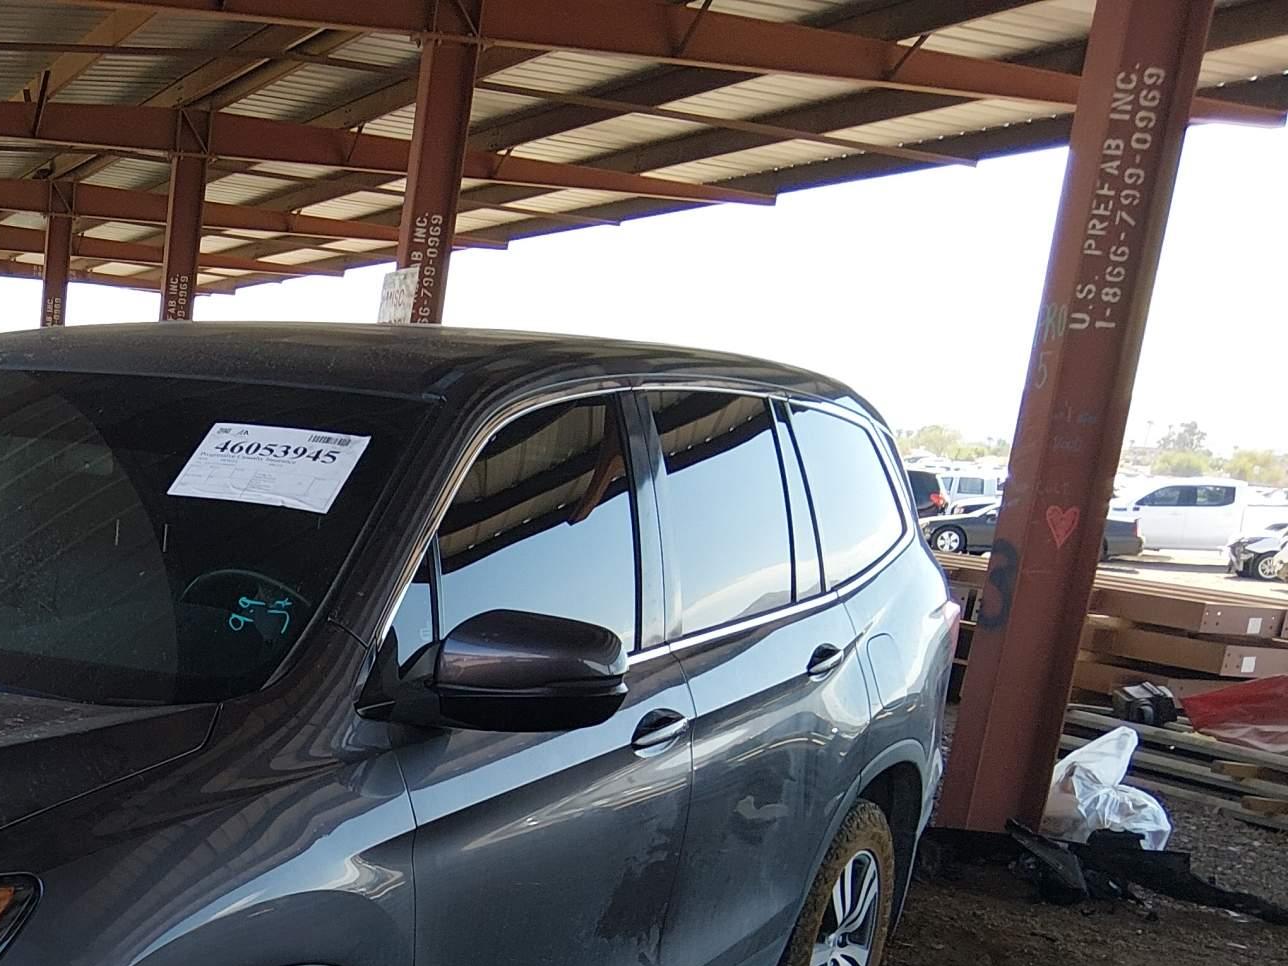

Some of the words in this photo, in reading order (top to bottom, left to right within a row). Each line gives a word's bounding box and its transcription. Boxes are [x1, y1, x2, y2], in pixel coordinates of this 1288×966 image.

[1109, 62, 1141, 121] INC.
[1083, 137, 1125, 256] PREFAB
[1094, 66, 1166, 329] 1-866-799-0969
[413, 212, 429, 243] INC.
[1069, 274, 1099, 330] U.S.
[215, 439, 340, 465] 46053945
